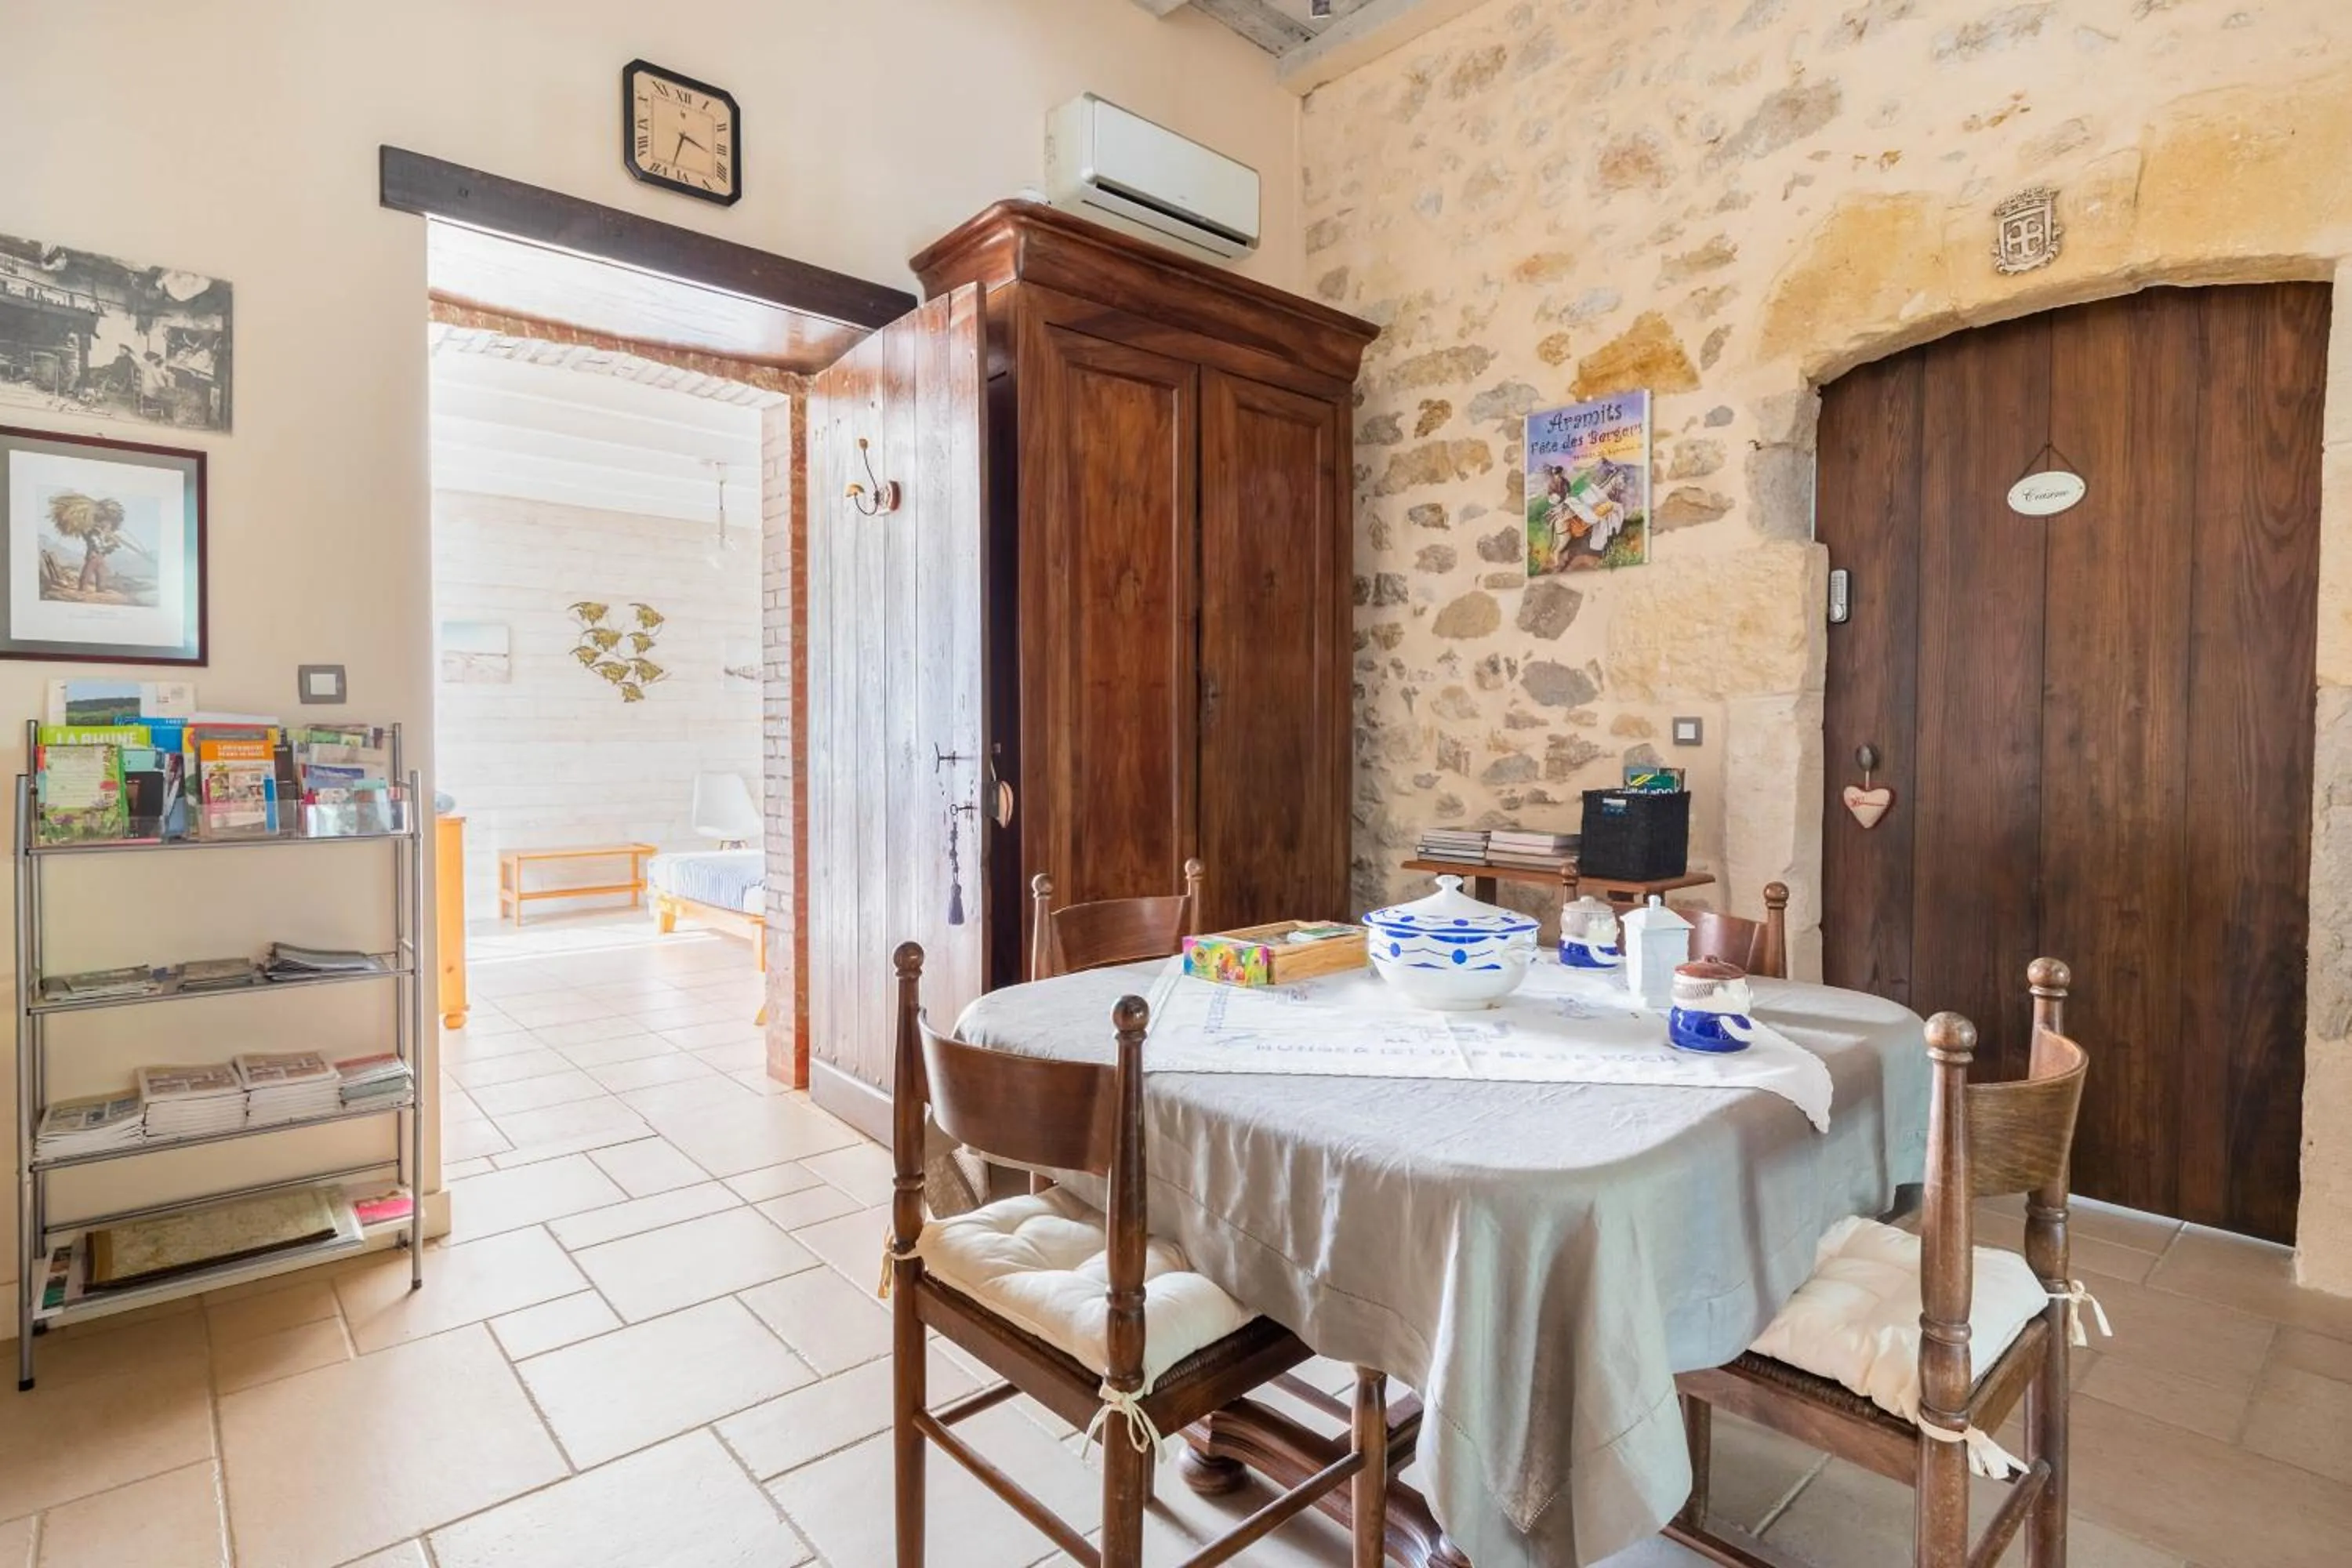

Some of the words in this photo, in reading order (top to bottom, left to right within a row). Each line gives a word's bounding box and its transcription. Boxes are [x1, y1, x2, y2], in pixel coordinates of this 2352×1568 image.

[675, 89, 692, 104] XII
[1547, 402, 1623, 434] Aramits
[1562, 434, 1584, 449] des
